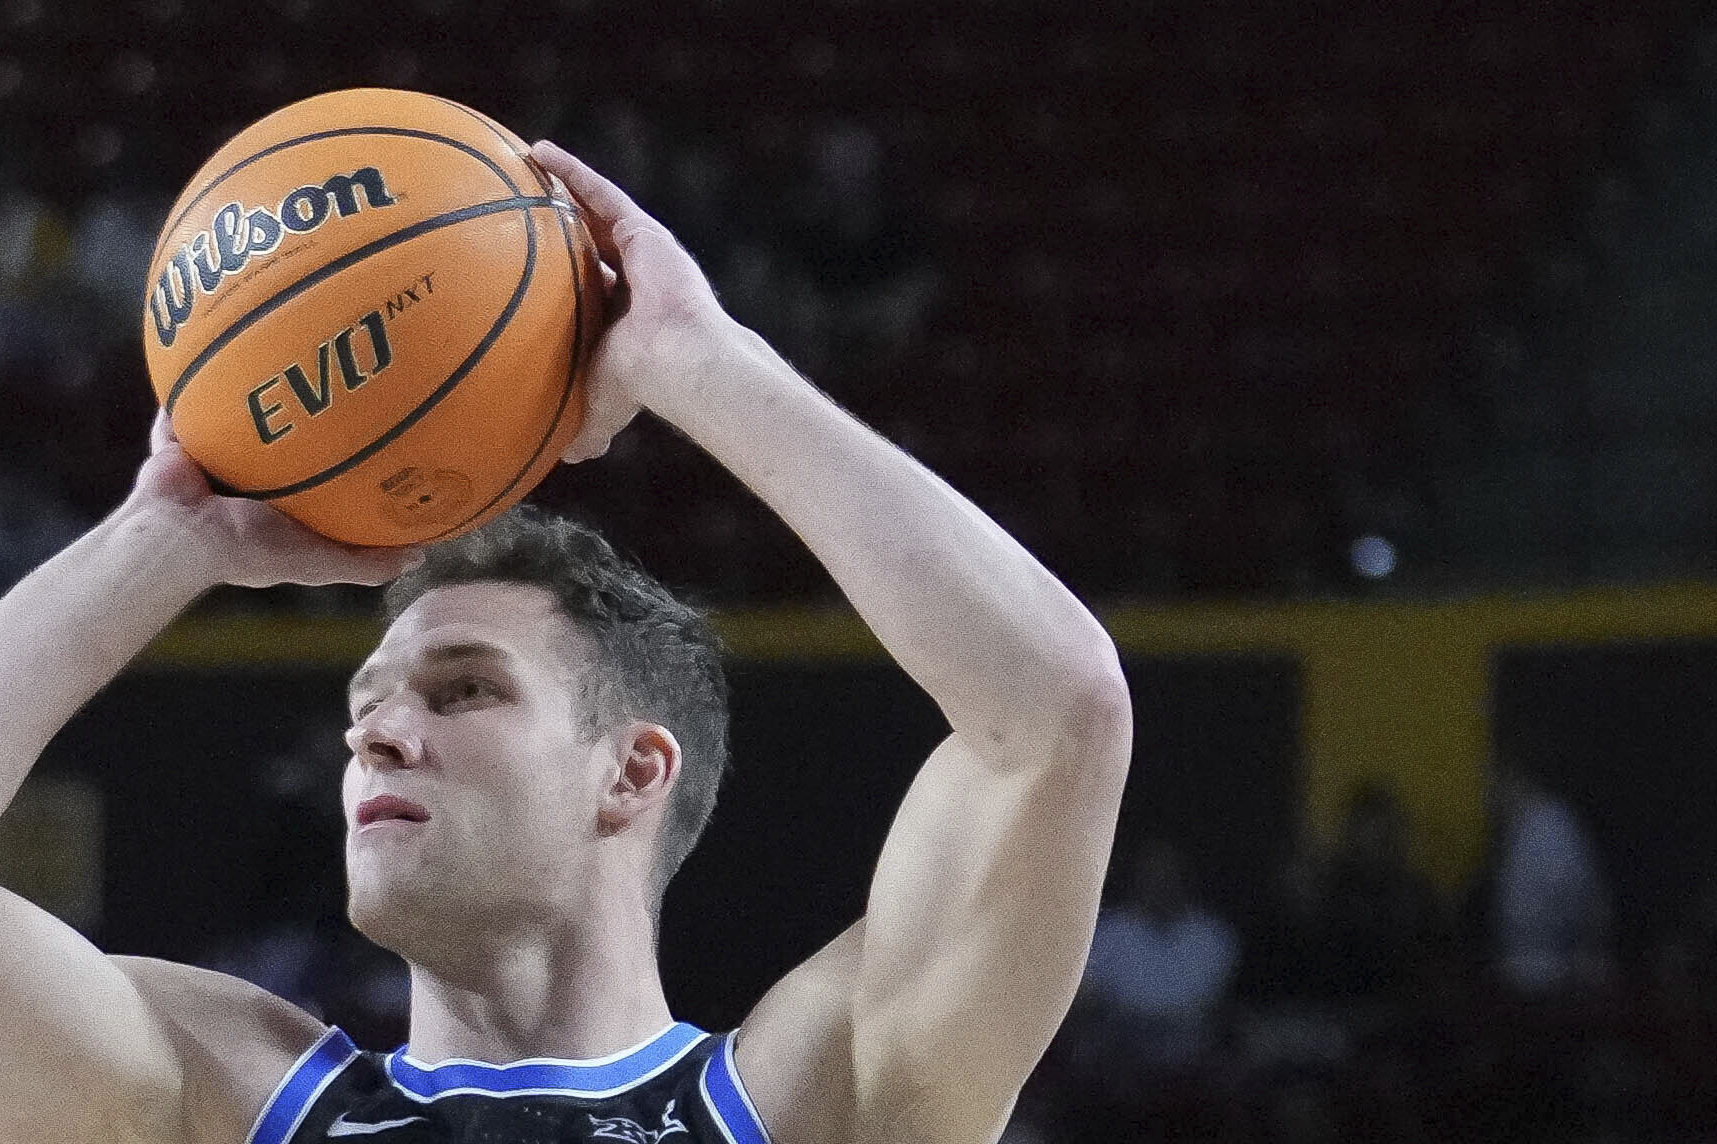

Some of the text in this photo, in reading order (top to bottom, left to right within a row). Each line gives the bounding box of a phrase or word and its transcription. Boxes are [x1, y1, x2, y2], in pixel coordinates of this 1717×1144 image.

[151, 166, 395, 347] Wilson
[246, 310, 393, 445] EVO
[386, 273, 435, 319] NXT
